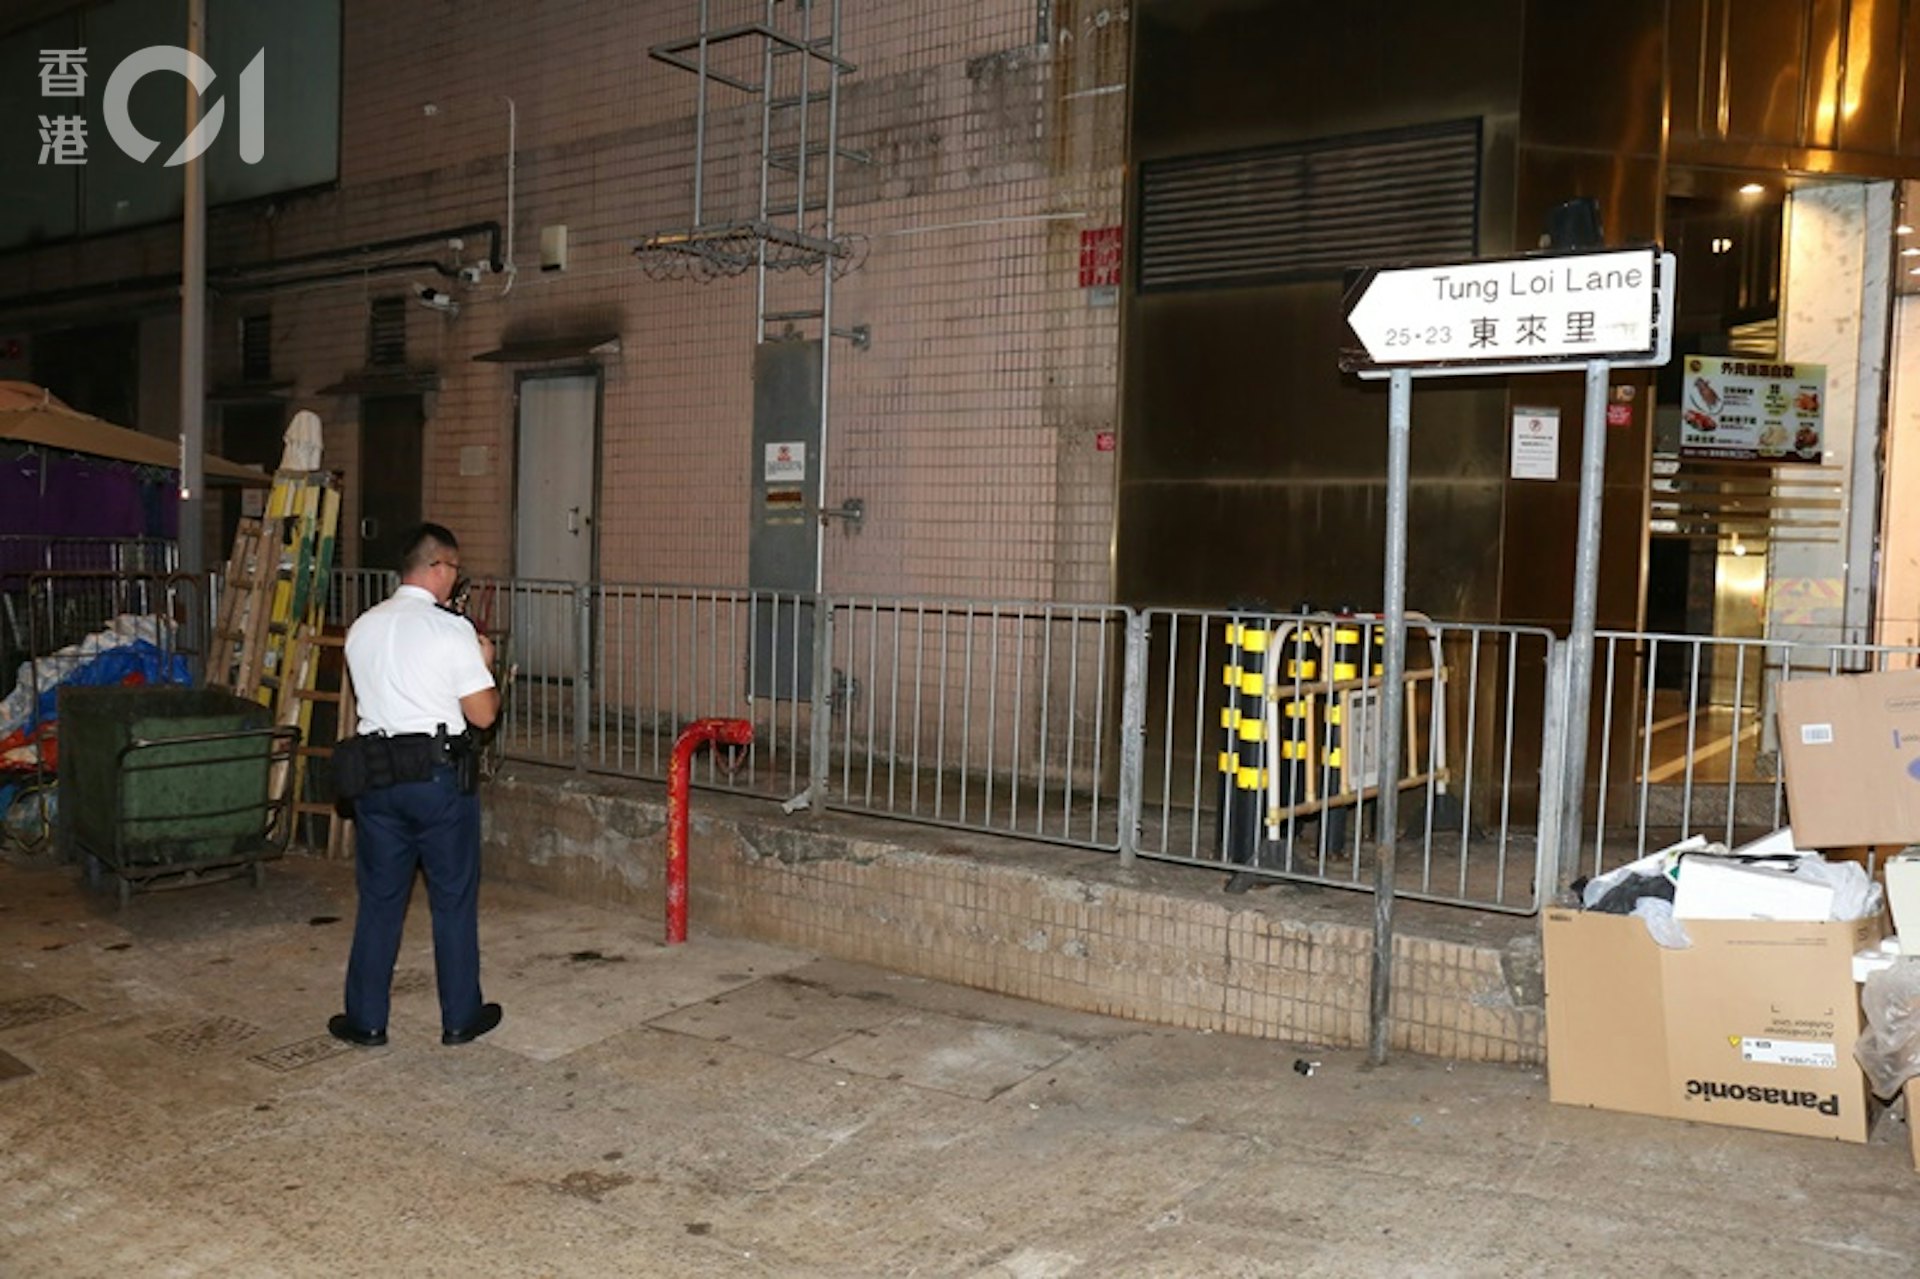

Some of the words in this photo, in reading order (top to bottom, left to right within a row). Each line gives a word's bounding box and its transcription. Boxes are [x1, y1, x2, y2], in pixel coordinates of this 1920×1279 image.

[1432, 275, 1499, 303] Tung
[1510, 269, 1554, 296] Loi
[1566, 267, 1643, 292] Lane
[1468, 311, 1597, 349] 東來里
[1687, 1080, 1839, 1116] Panasonic
